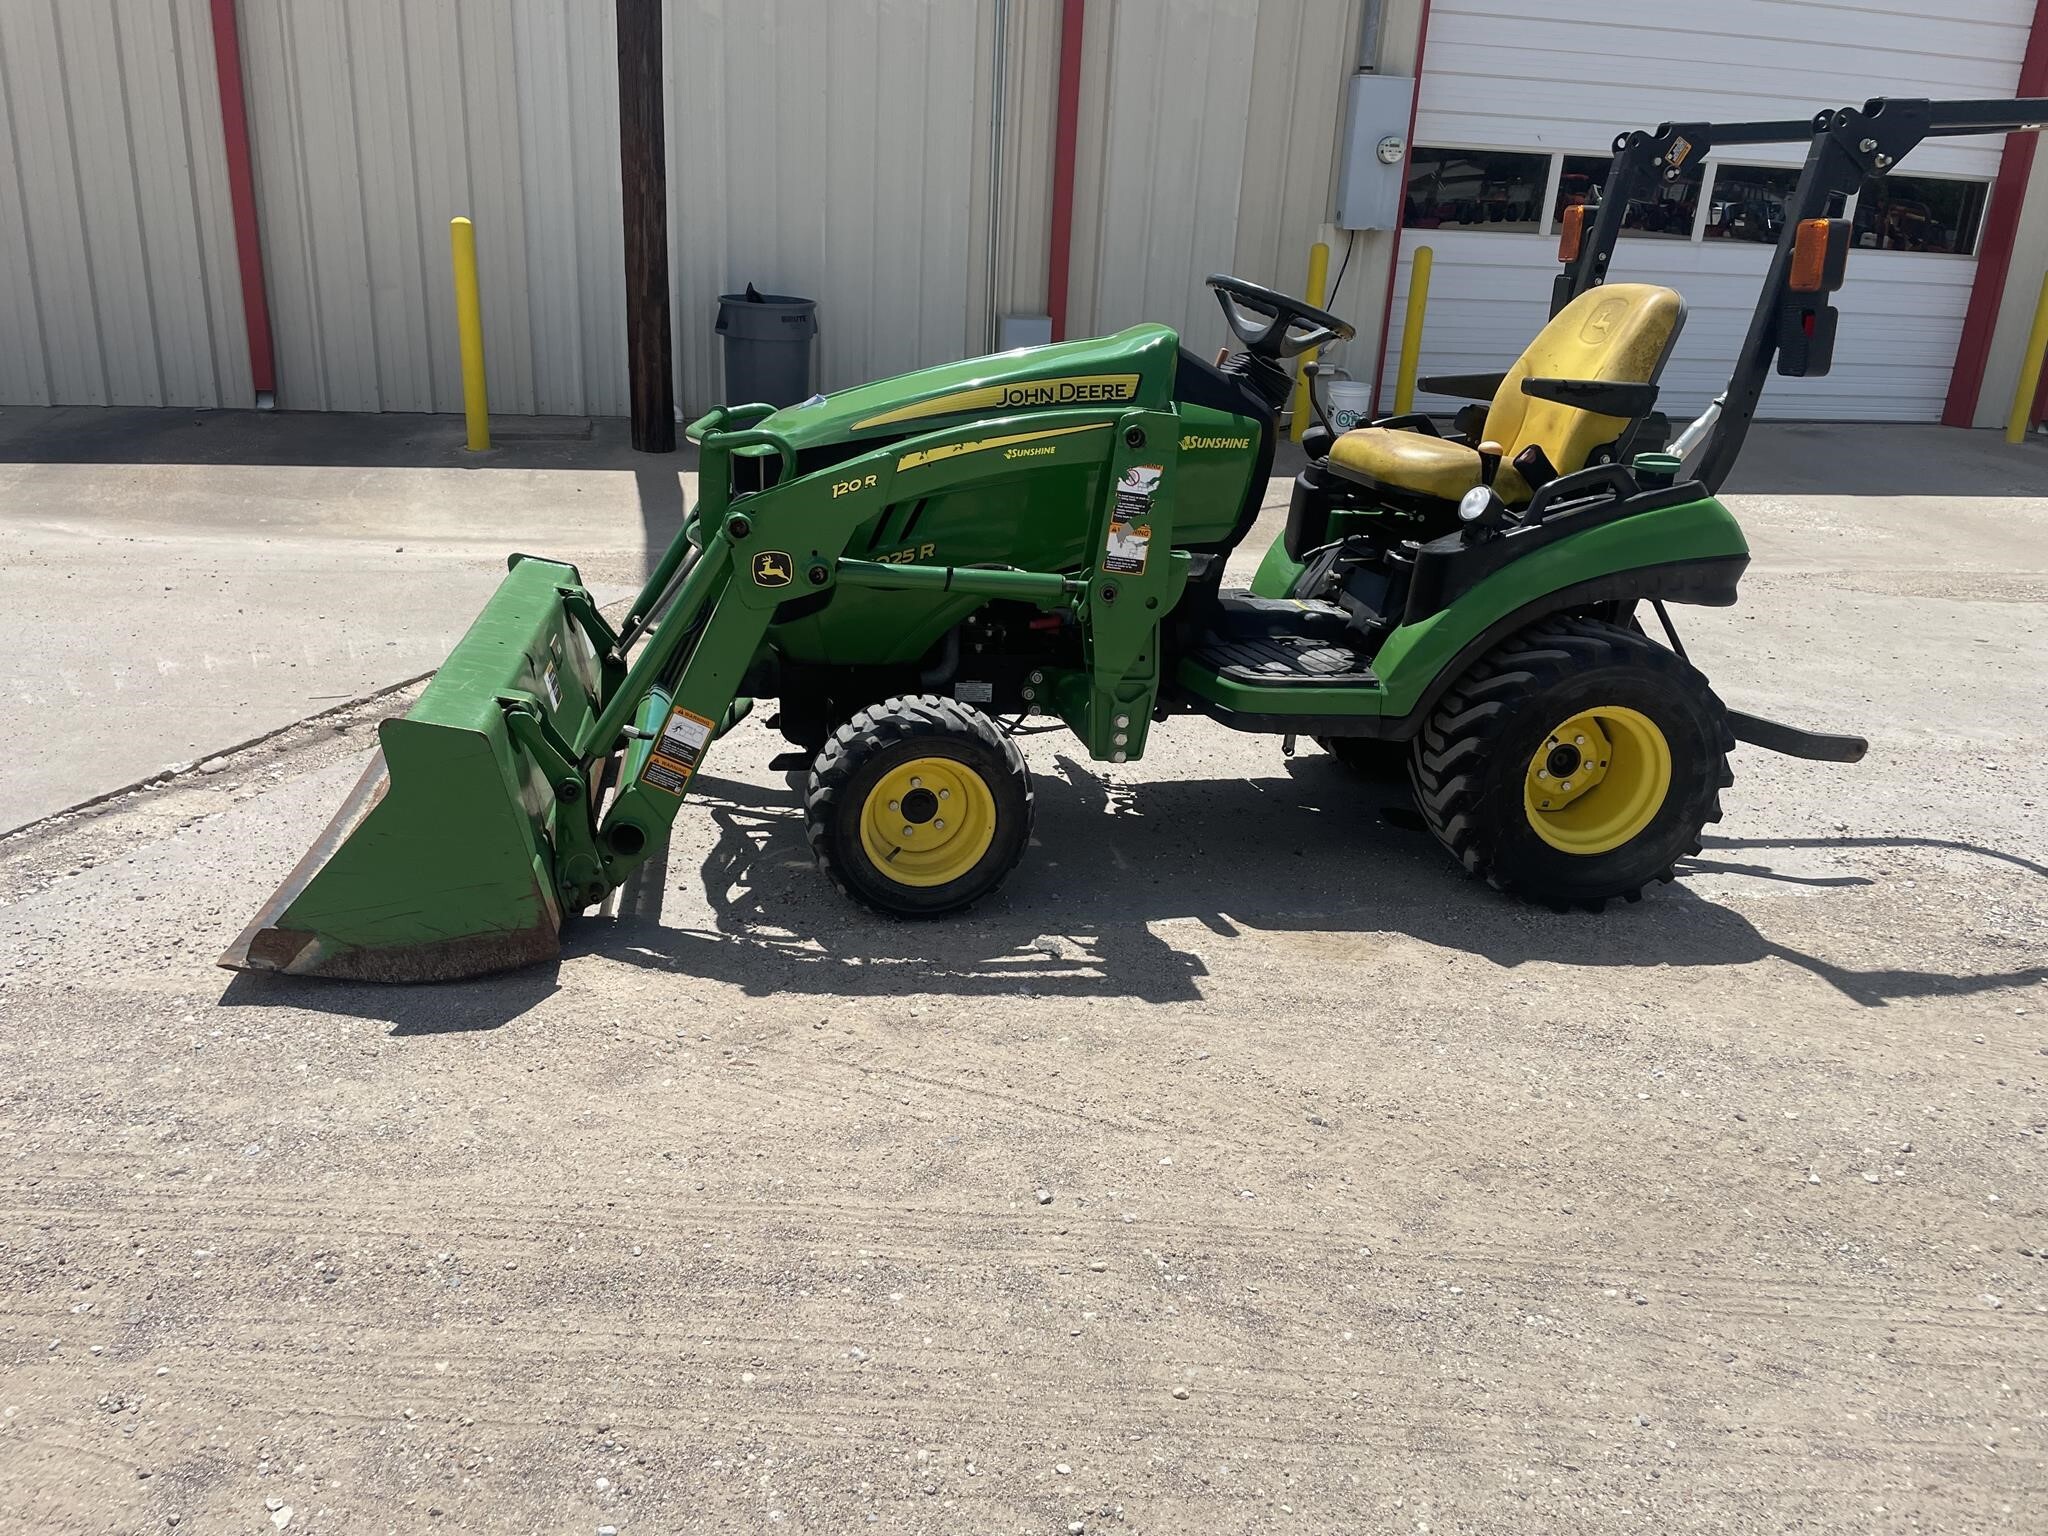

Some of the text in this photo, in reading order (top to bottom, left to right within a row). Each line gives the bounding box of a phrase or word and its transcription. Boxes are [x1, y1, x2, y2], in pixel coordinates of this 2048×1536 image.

[996, 383, 1127, 406] JOHN DEERE
[1188, 435, 1250, 449] SUNSHINE
[1011, 446, 1056, 458] SUNSHINE
[832, 474, 878, 499] 120 R
[919, 543, 936, 560] R
[684, 710, 710, 726] WARNING
[661, 760, 687, 775] WARNING
